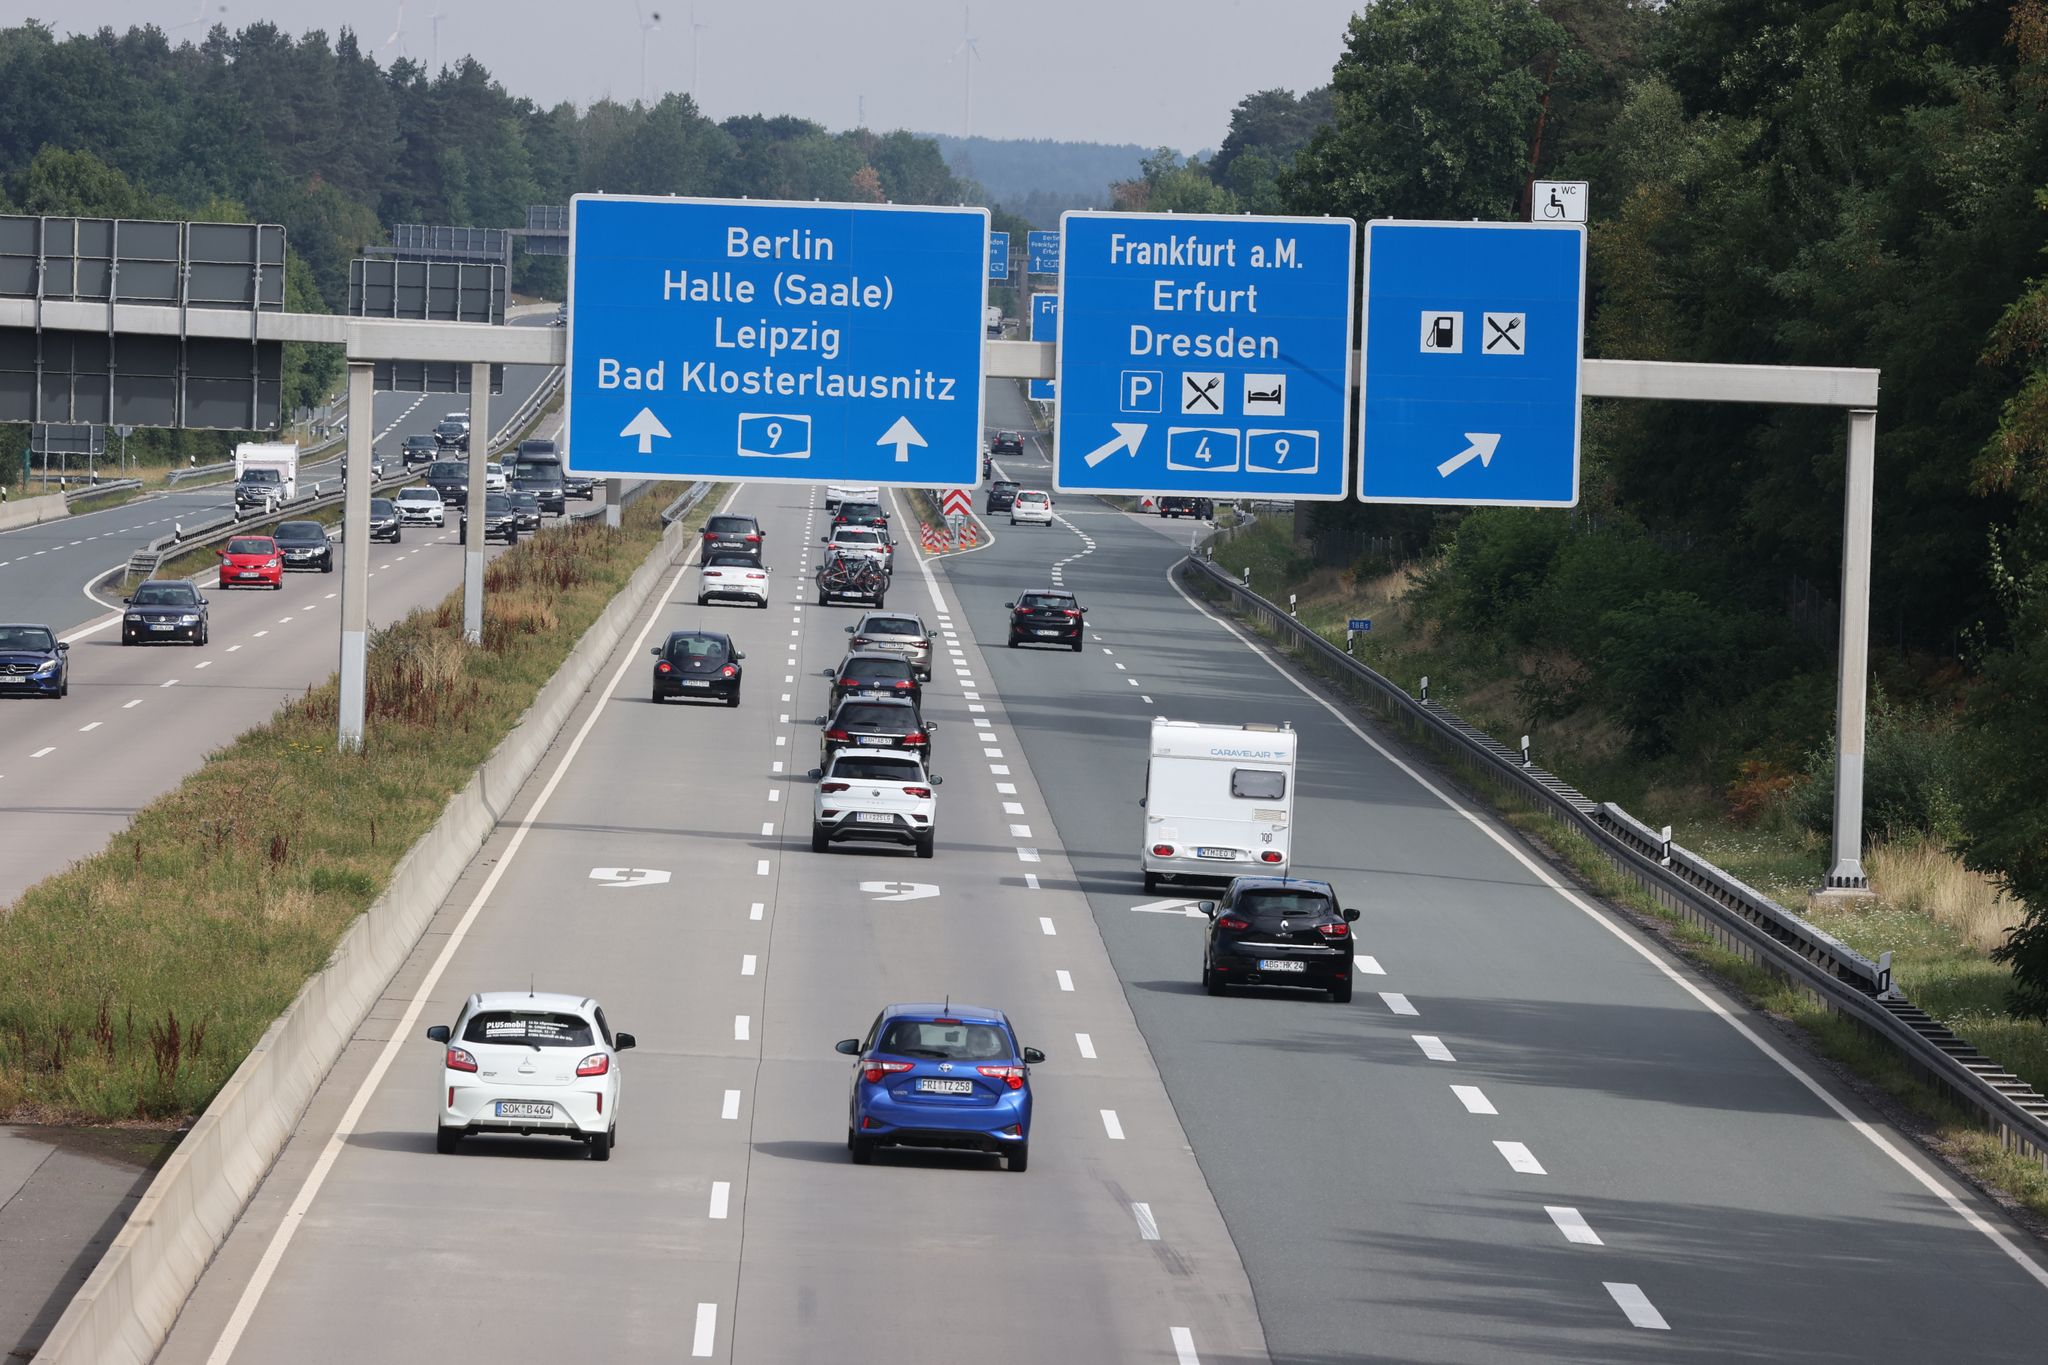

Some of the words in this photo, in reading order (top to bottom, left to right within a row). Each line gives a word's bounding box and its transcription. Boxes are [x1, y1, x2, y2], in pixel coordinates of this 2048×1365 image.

[1561, 186, 1576, 195] WC
[728, 227, 833, 261] Berlin
[1111, 234, 1235, 267] Frankfurt
[1251, 239, 1303, 269] a.M.
[664, 270, 755, 303] Halle
[774, 272, 893, 310] (Saale)
[1155, 281, 1258, 313] Erfurt
[1042, 302, 1058, 314] Fr
[716, 317, 840, 360] Leipzig
[1130, 325, 1279, 360] Dresden
[598, 358, 665, 391] Bad
[682, 361, 956, 401] Klosterlausnitz
[1131, 377, 1153, 407] P
[767, 422, 783, 449] 9
[1195, 436, 1212, 463] 4
[1273, 438, 1290, 465] 9
[1211, 748, 1271, 758] CARAVELAIR
[486, 1021, 526, 1029] PLUSmobil
[922, 1080, 937, 1090] FRI
[956, 1082, 970, 1092] 258
[502, 1104, 521, 1114] SOK
